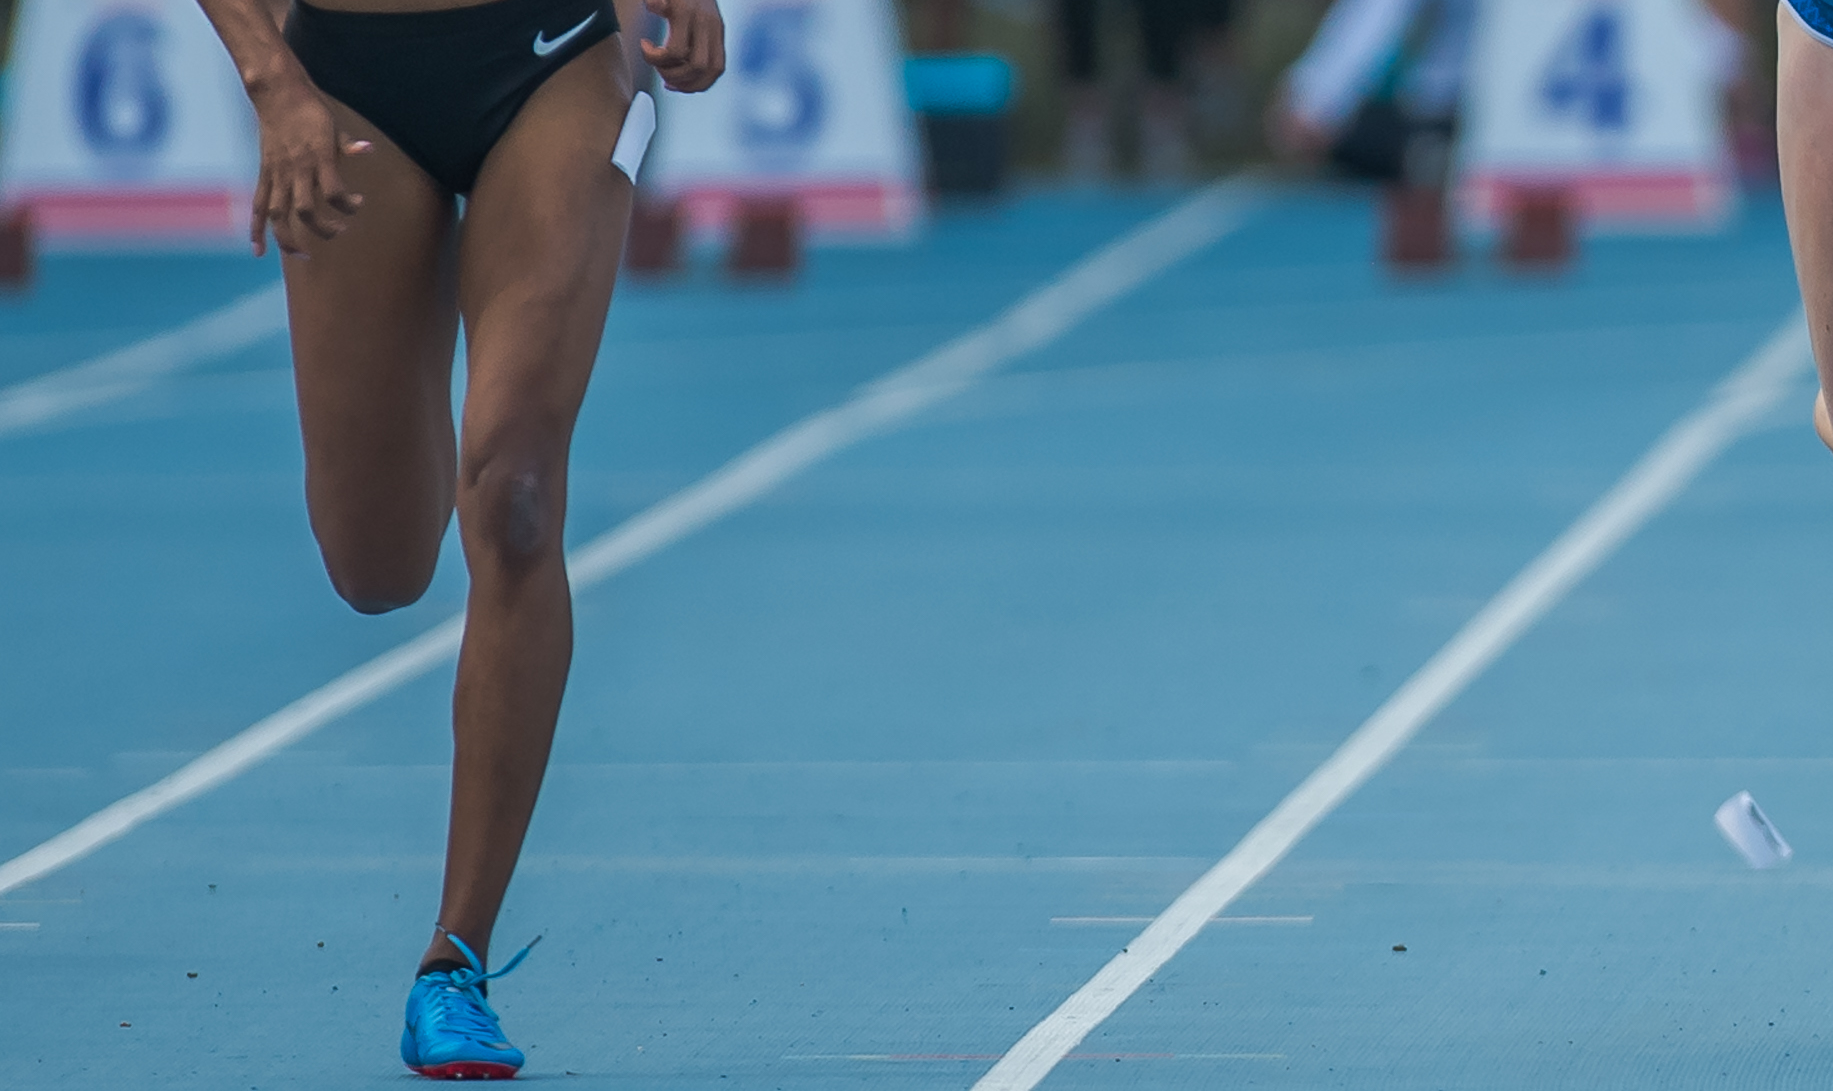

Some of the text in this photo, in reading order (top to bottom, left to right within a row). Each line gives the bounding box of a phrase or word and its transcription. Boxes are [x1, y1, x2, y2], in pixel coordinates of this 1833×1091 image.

[72, 11, 173, 157] 6
[738, 5, 828, 149] 5
[1538, 3, 1632, 133] 4
